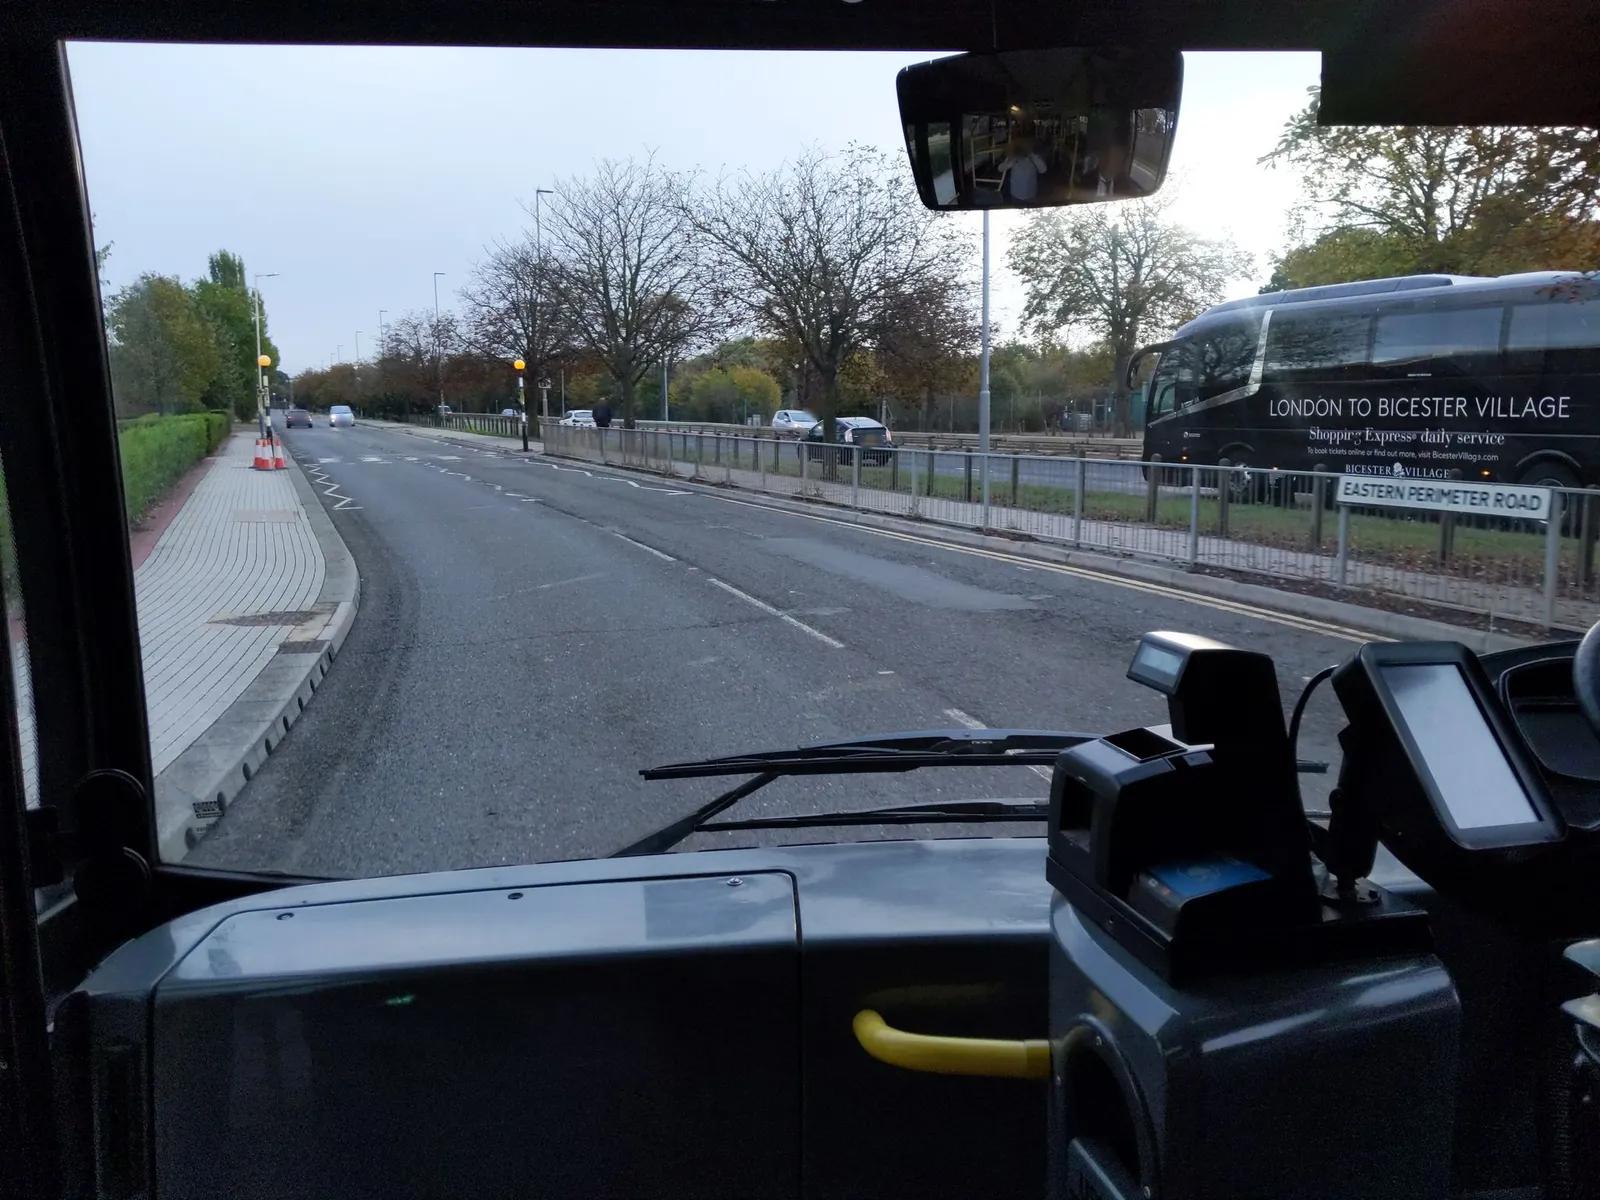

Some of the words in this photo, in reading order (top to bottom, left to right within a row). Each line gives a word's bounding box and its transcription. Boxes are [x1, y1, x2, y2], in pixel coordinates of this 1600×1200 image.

[1270, 398, 1342, 417] LONDON
[1348, 397, 1372, 417] TO
[1378, 396, 1468, 418] BICESTER
[1475, 396, 1571, 418] VILLAGE
[1309, 426, 1362, 446] Shopping
[1420, 427, 1453, 449] daily
[1456, 429, 1505, 446] service
[1307, 446, 1314, 454] To
[1314, 446, 1328, 455] book
[1328, 446, 1347, 456] tickets
[1347, 448, 1366, 456] online
[1374, 448, 1386, 457] find
[1386, 450, 1398, 458] out
[1418, 450, 1431, 459] visit
[1345, 464, 1392, 476] BICESTER
[1404, 466, 1452, 479] VILLAGE
[1343, 481, 1406, 500] EASTERN
[1407, 486, 1490, 508] PERIMETER
[1493, 492, 1542, 511] ROAD
